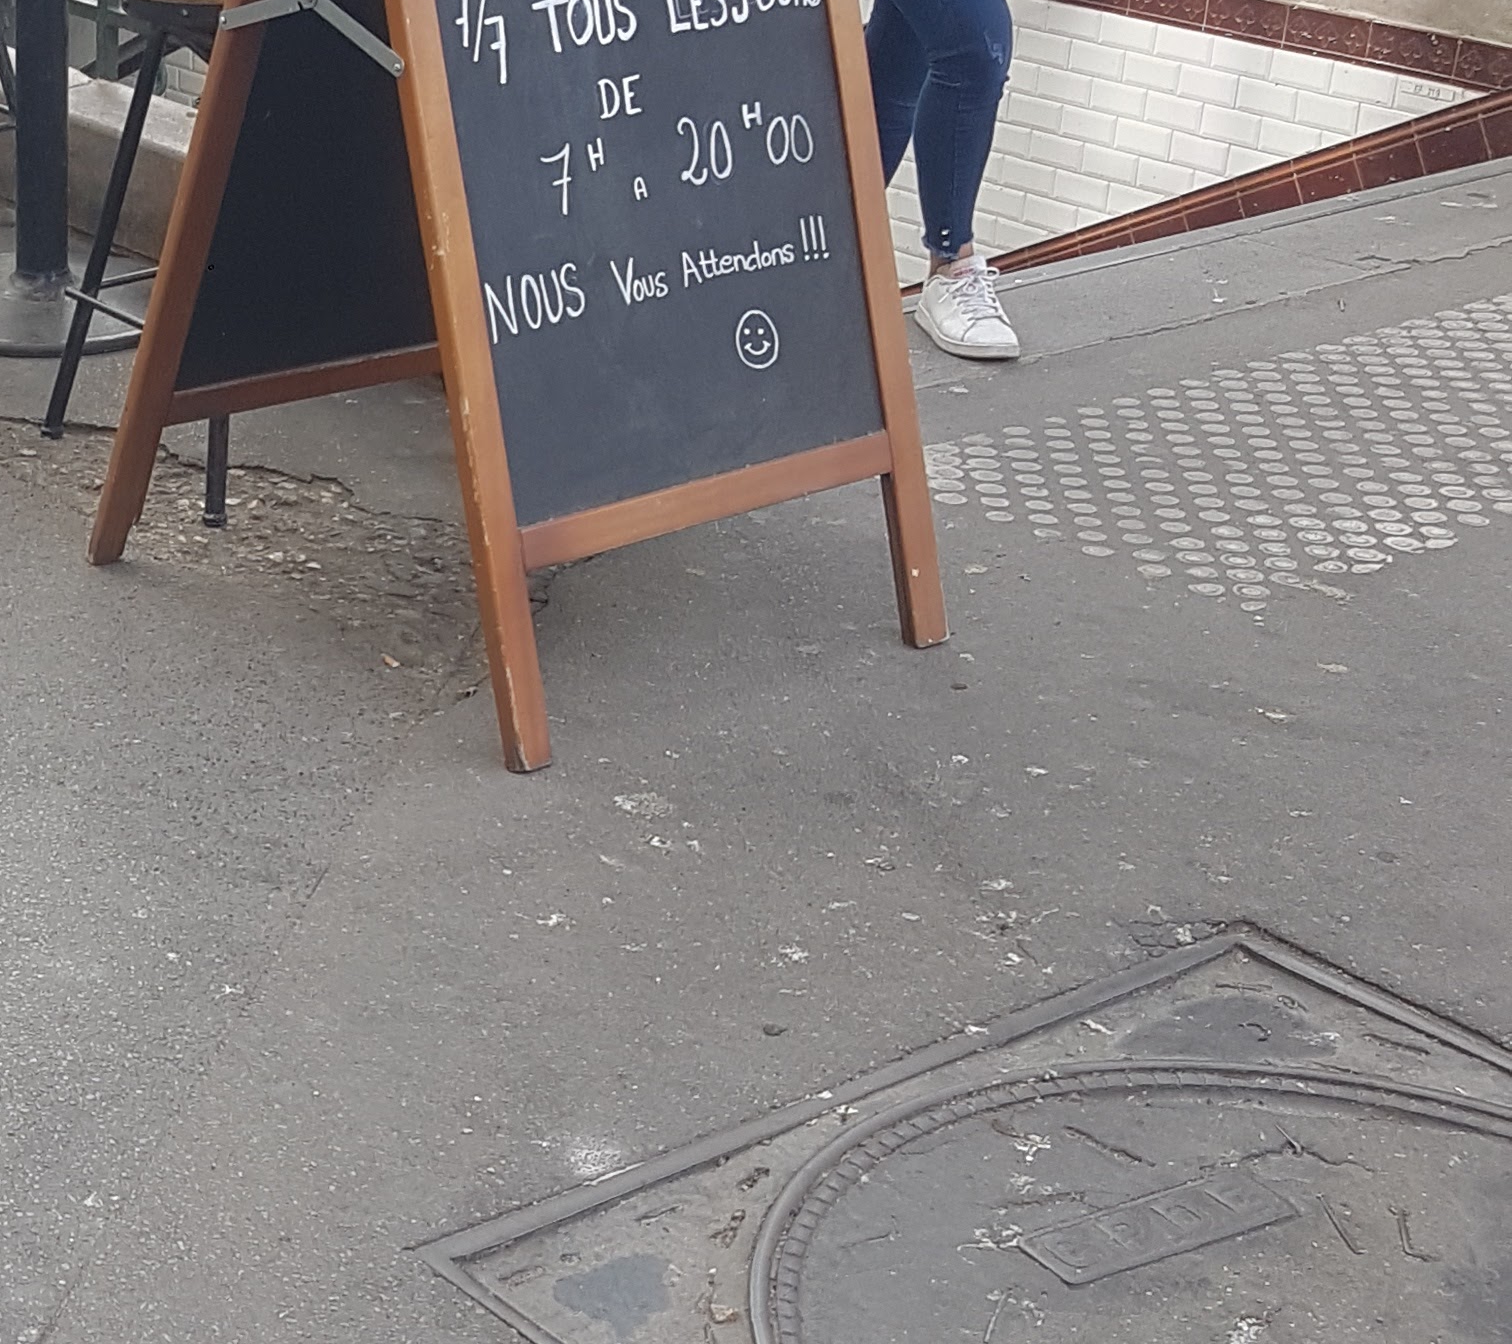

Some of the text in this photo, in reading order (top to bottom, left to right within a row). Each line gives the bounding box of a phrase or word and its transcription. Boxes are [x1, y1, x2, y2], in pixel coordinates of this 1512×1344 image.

[597, 73, 643, 120] DE
[484, 262, 587, 346] NOUS
[609, 256, 670, 306] Vous
